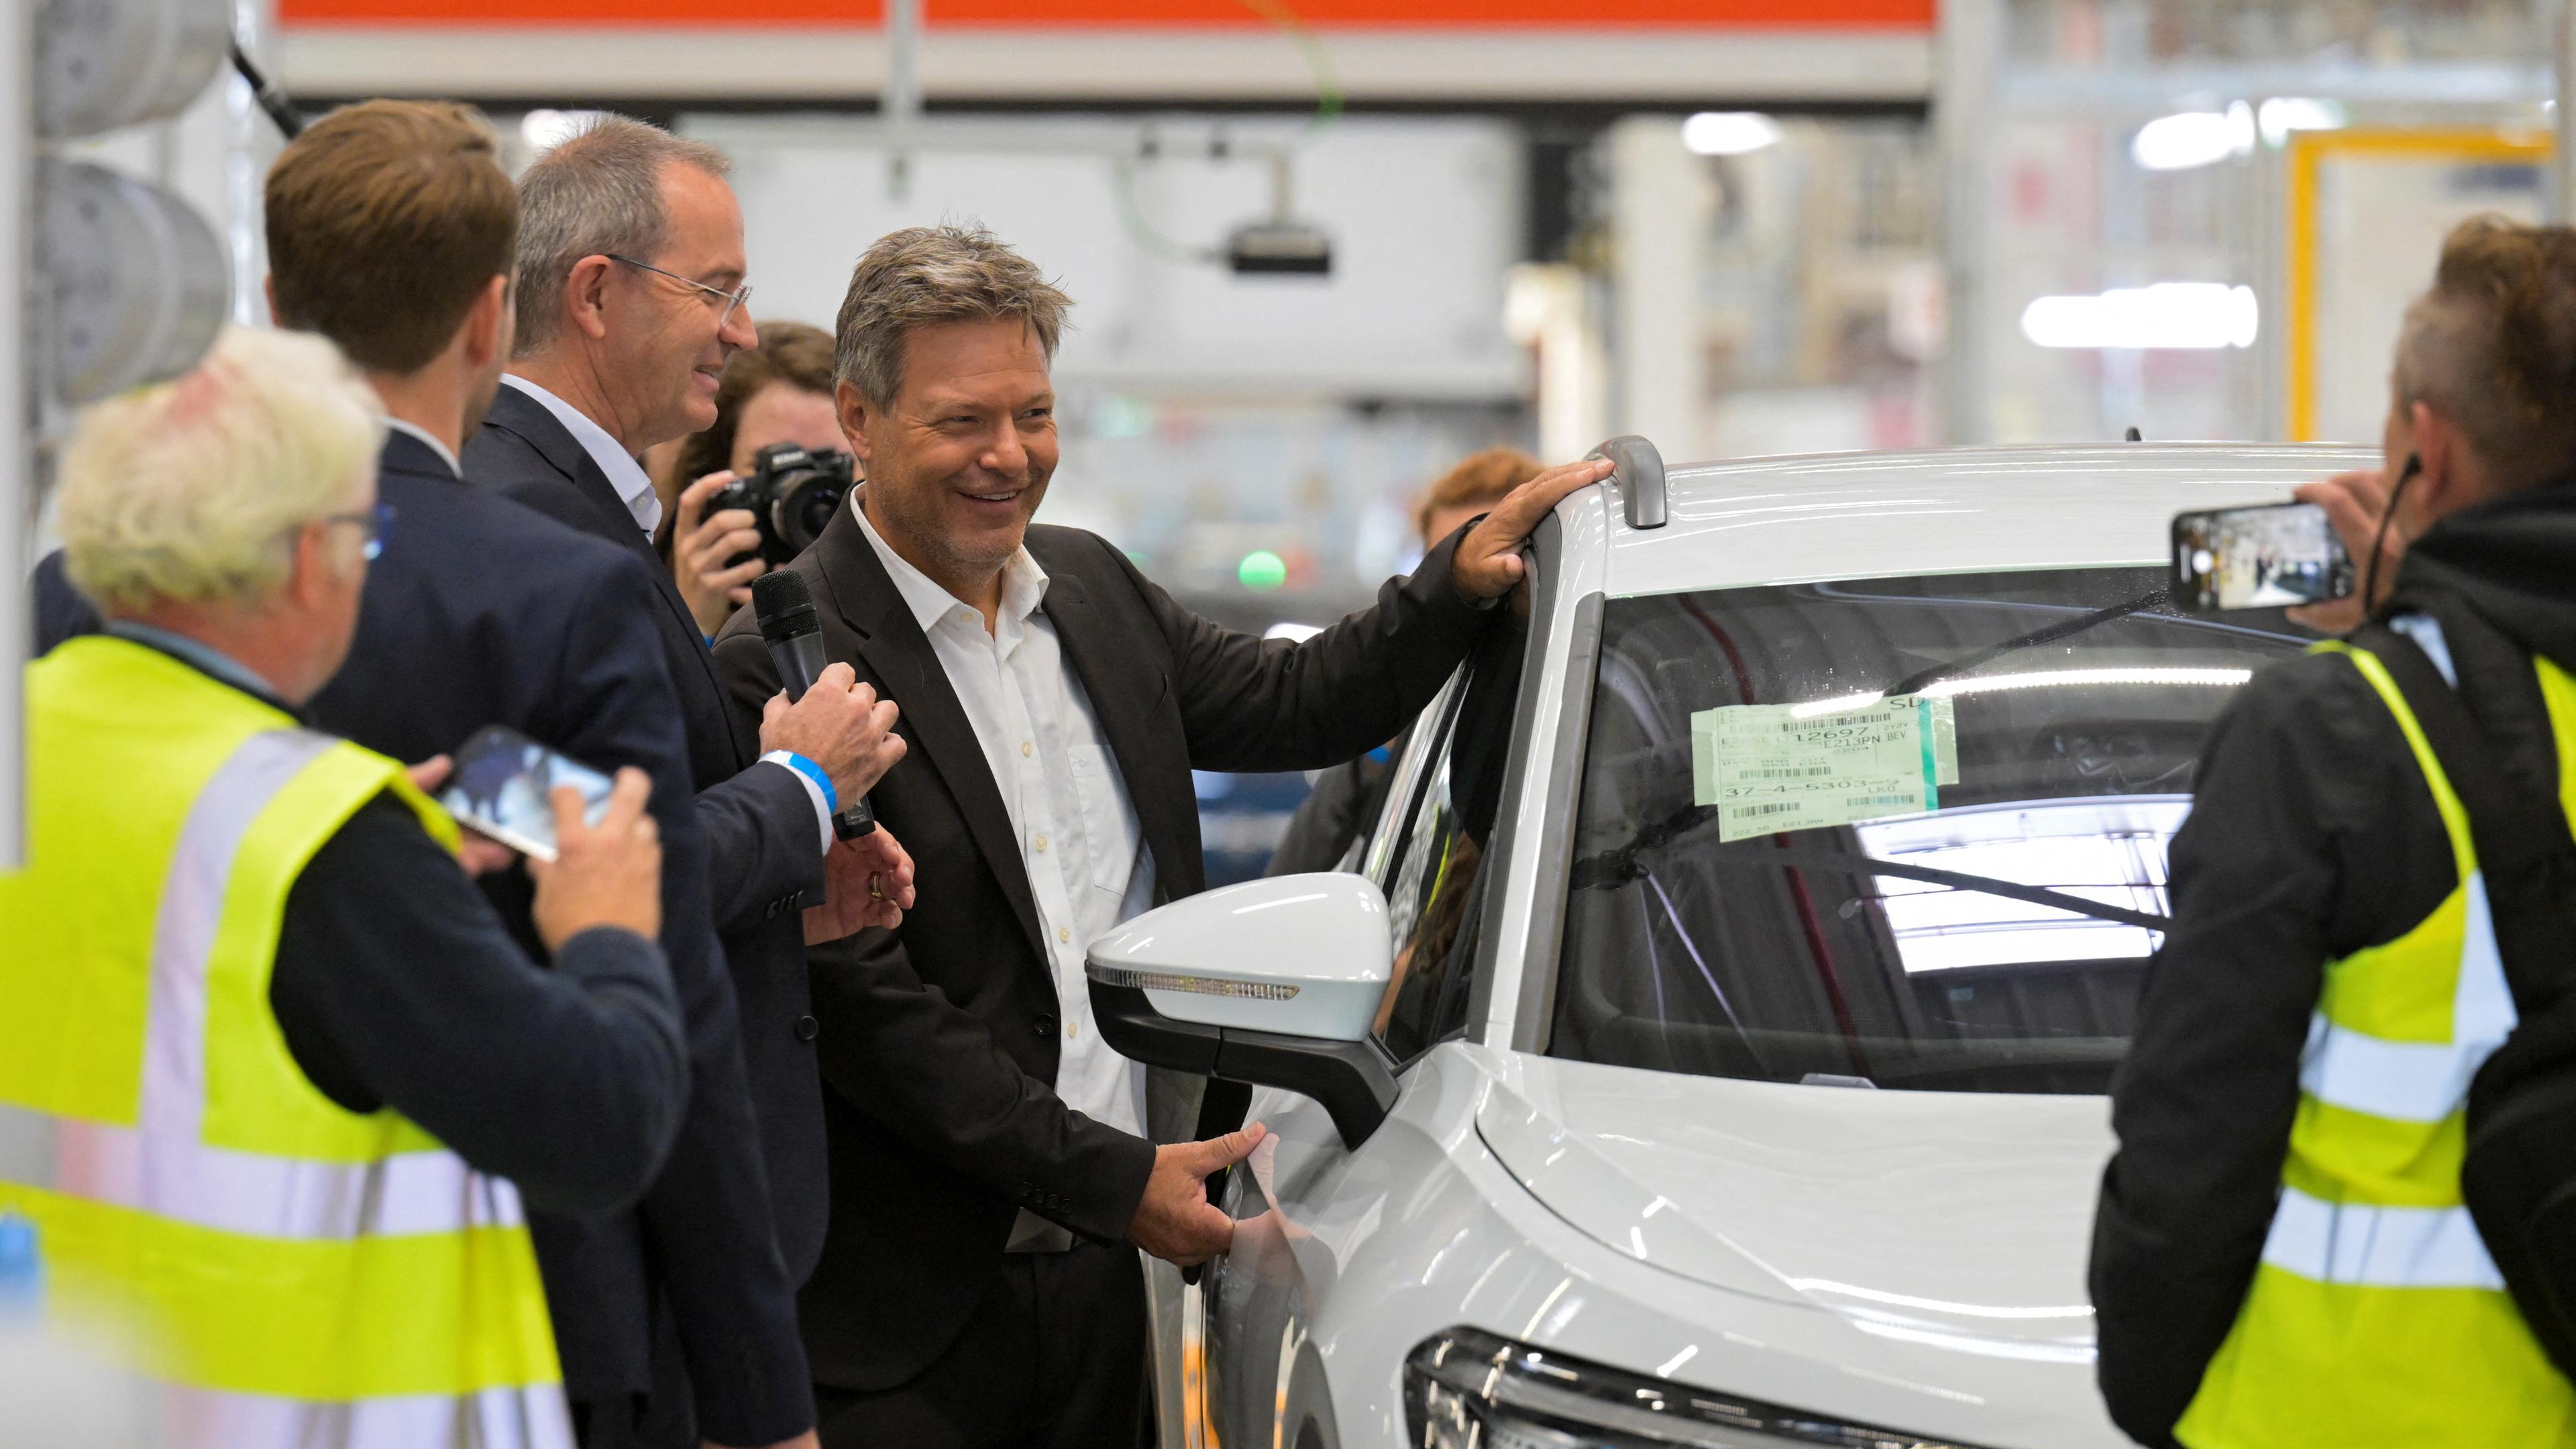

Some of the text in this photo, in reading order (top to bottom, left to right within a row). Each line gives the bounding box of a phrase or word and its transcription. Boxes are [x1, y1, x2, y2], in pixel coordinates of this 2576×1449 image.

[1792, 727, 1869, 742] 12697
[1887, 731, 1906, 741] BEV
[1824, 735, 1880, 749] E213RN
